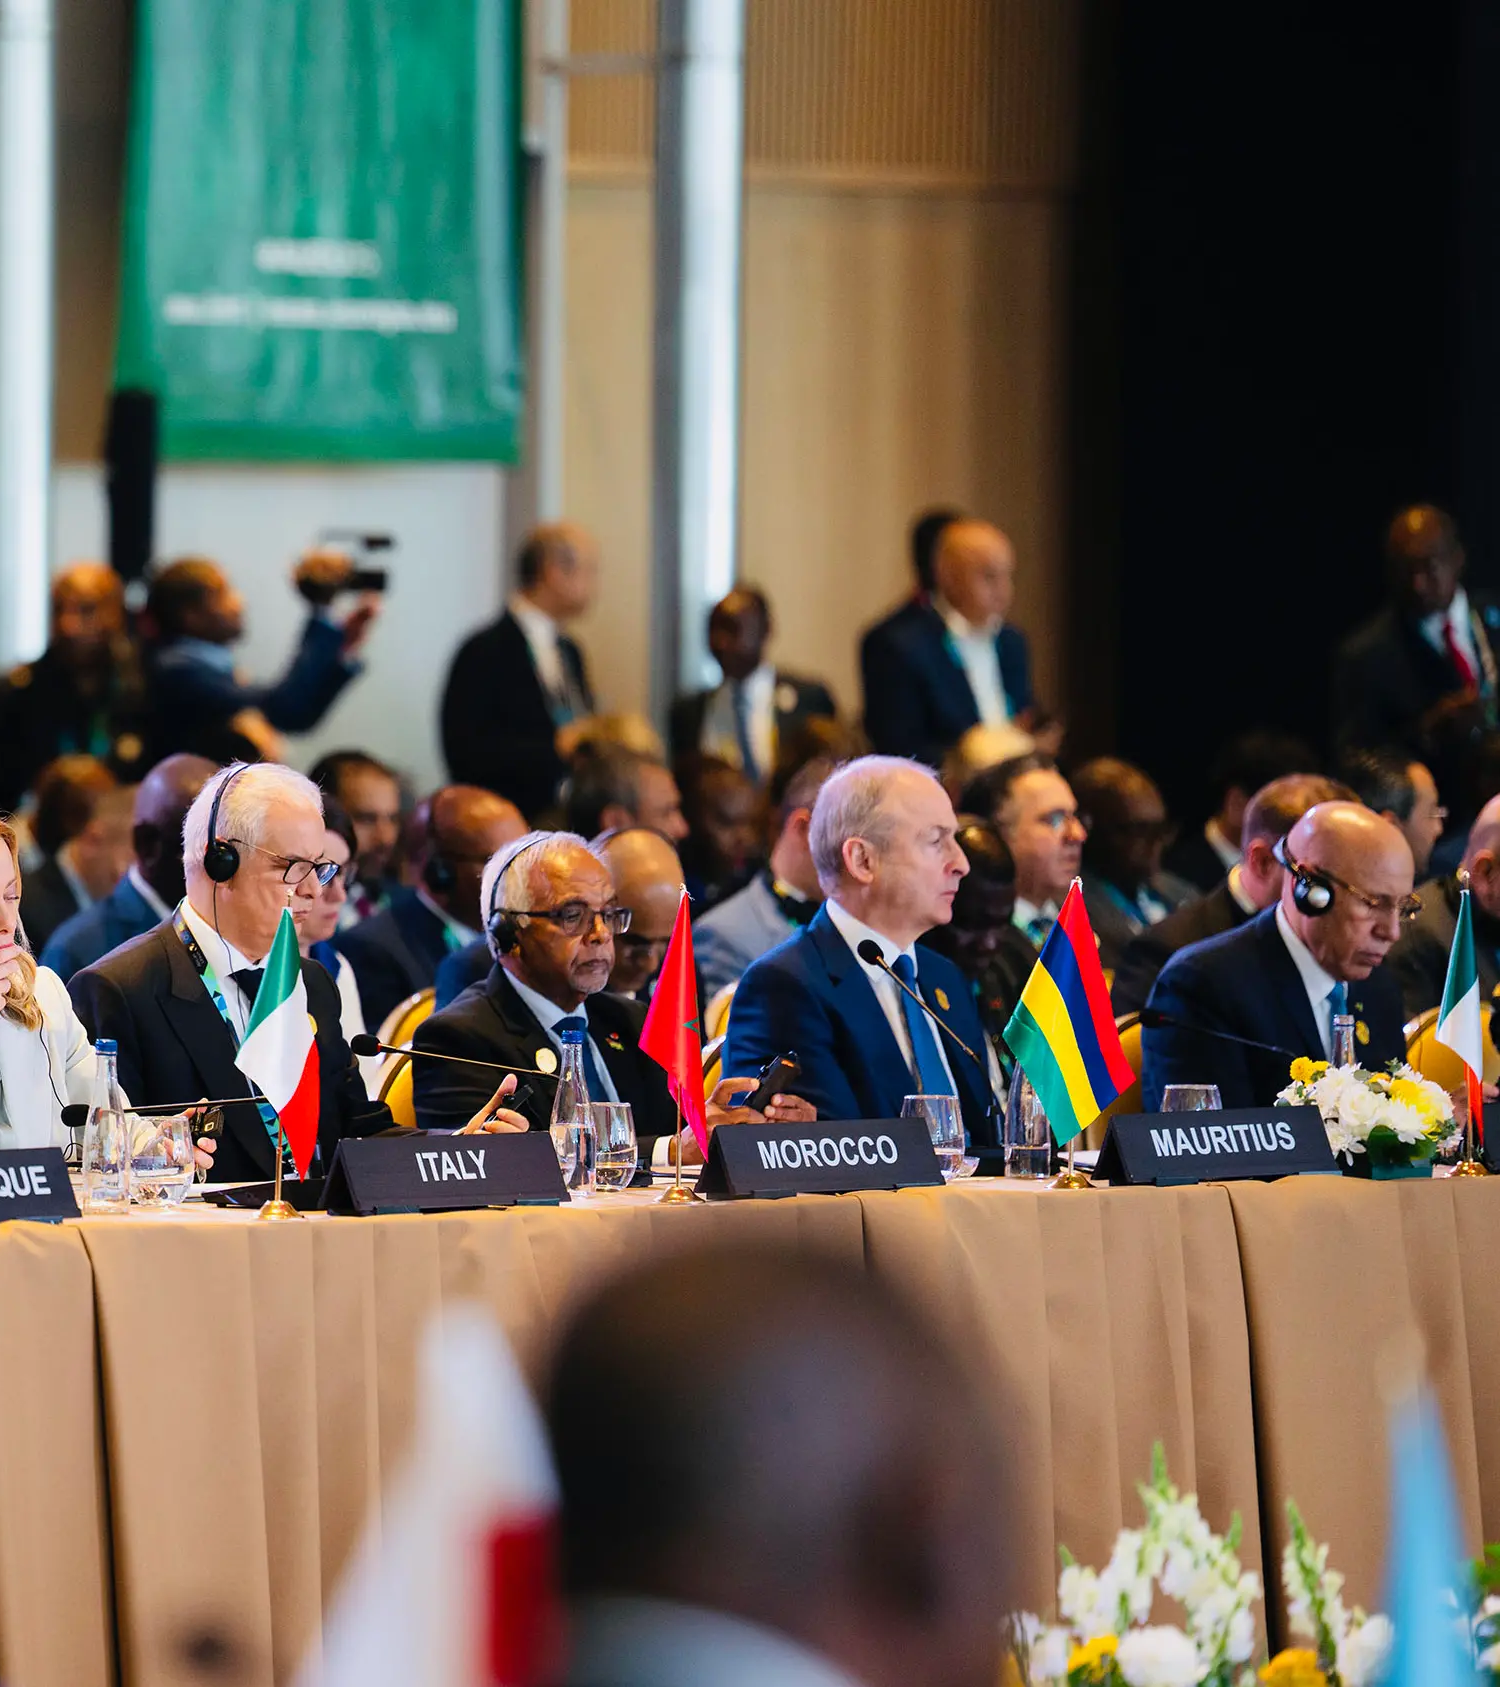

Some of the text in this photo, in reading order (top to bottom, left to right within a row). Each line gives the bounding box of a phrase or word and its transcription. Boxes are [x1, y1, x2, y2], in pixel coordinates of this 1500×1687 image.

[757, 1135, 898, 1169] MOROCCO
[1150, 1122, 1296, 1157] MAURITIUS
[415, 1150, 487, 1182] ITALY
